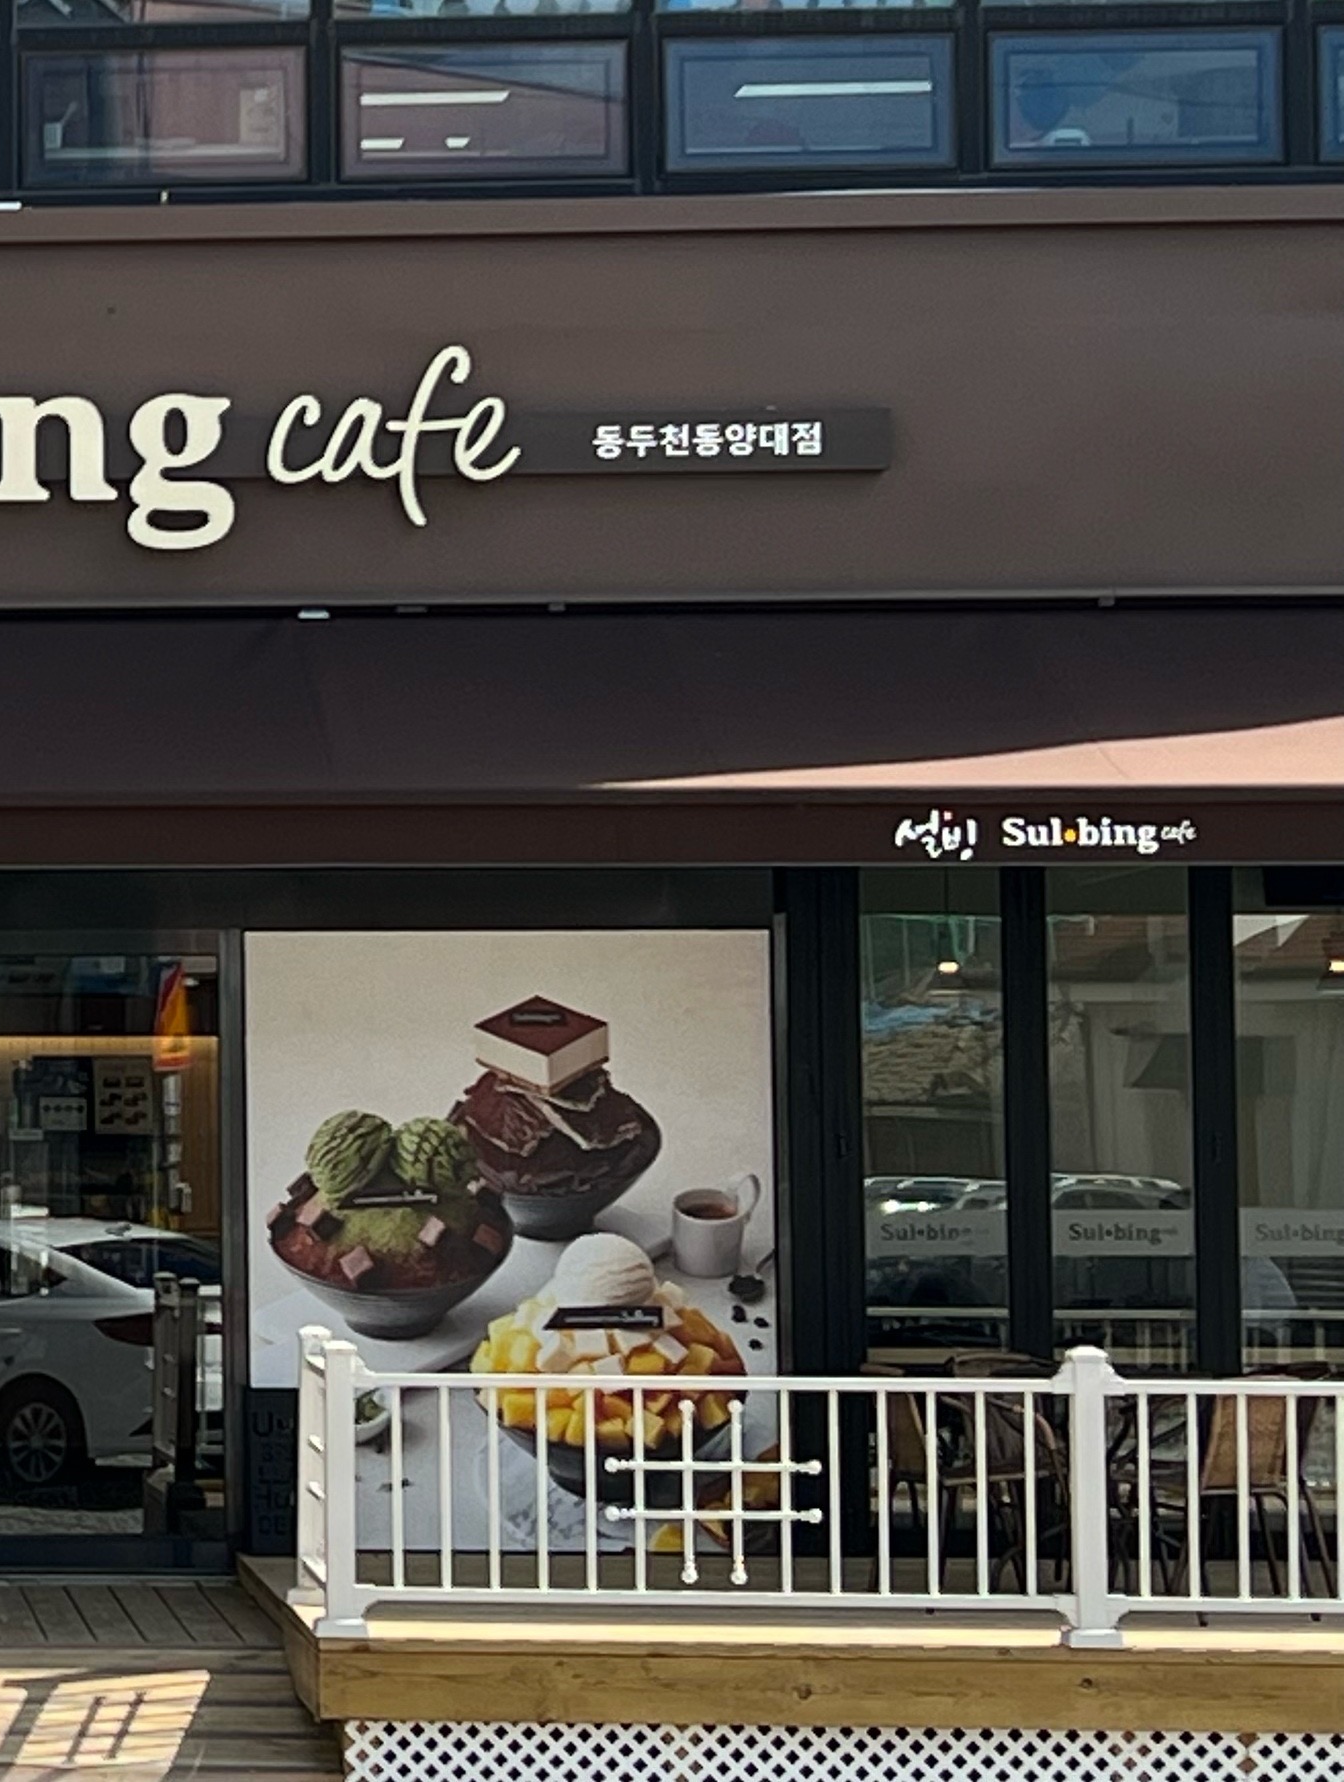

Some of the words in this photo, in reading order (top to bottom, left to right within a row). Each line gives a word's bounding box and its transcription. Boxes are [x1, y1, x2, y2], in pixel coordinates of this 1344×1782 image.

[266, 344, 522, 527] cafe
[591, 420, 823, 461] 동두천동양대점
[894, 808, 979, 861] 설빙
